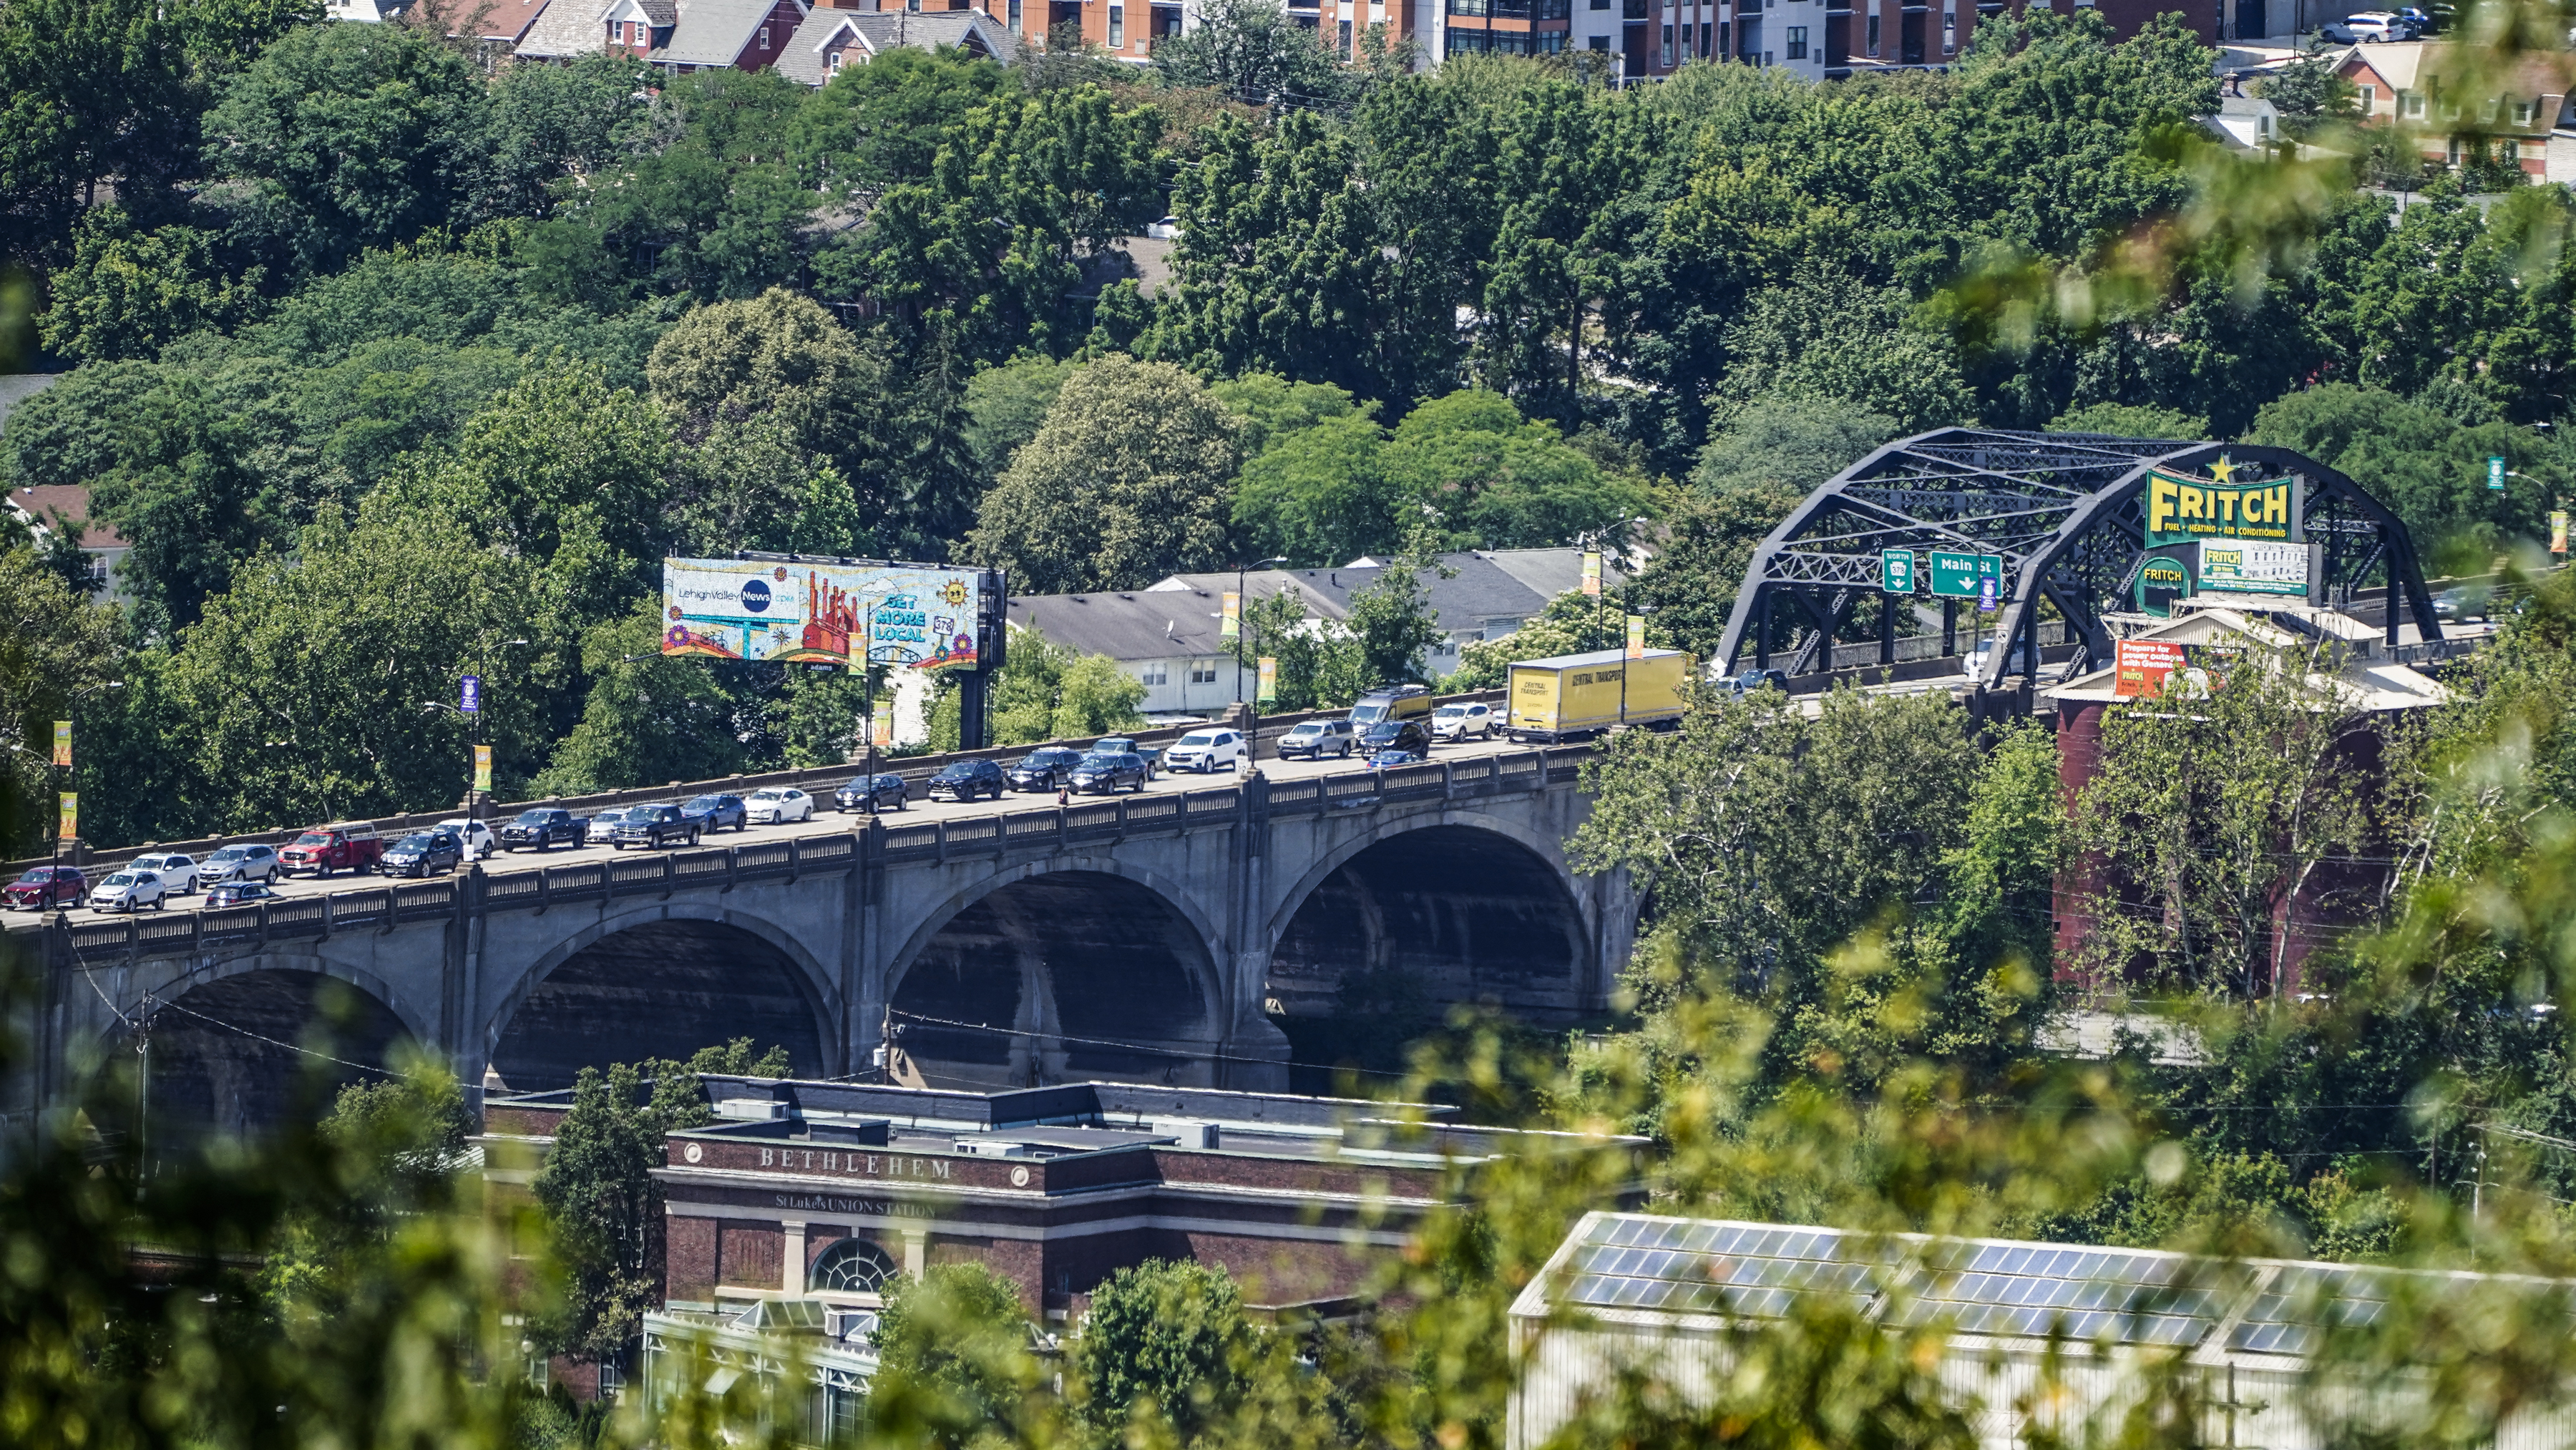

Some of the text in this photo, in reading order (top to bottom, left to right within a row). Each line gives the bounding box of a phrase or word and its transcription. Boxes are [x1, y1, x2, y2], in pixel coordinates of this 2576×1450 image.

[2150, 476, 2288, 532] FRITCH
[2165, 522, 2286, 538] FUEL HEATING AIR CONDITIONING
[2206, 550, 2240, 564] FRITCH
[1941, 558, 1991, 573] Main St
[2144, 568, 2182, 581] FRITCH
[884, 593, 918, 609] GET
[875, 609, 926, 627] MORE
[936, 620, 952, 631] 378
[874, 626, 925, 643] LOCAL
[2123, 643, 2156, 652] Prepare
[2142, 660, 2173, 668] Genera
[2150, 653, 2185, 662] outages
[1573, 673, 1593, 686] CENTRAL
[1521, 688, 1549, 696] TRANSPORT
[761, 1147, 951, 1179] BETHLEHEM
[776, 1194, 787, 1207] St
[828, 1197, 873, 1213] UNION
[875, 1202, 937, 1218] STATION
